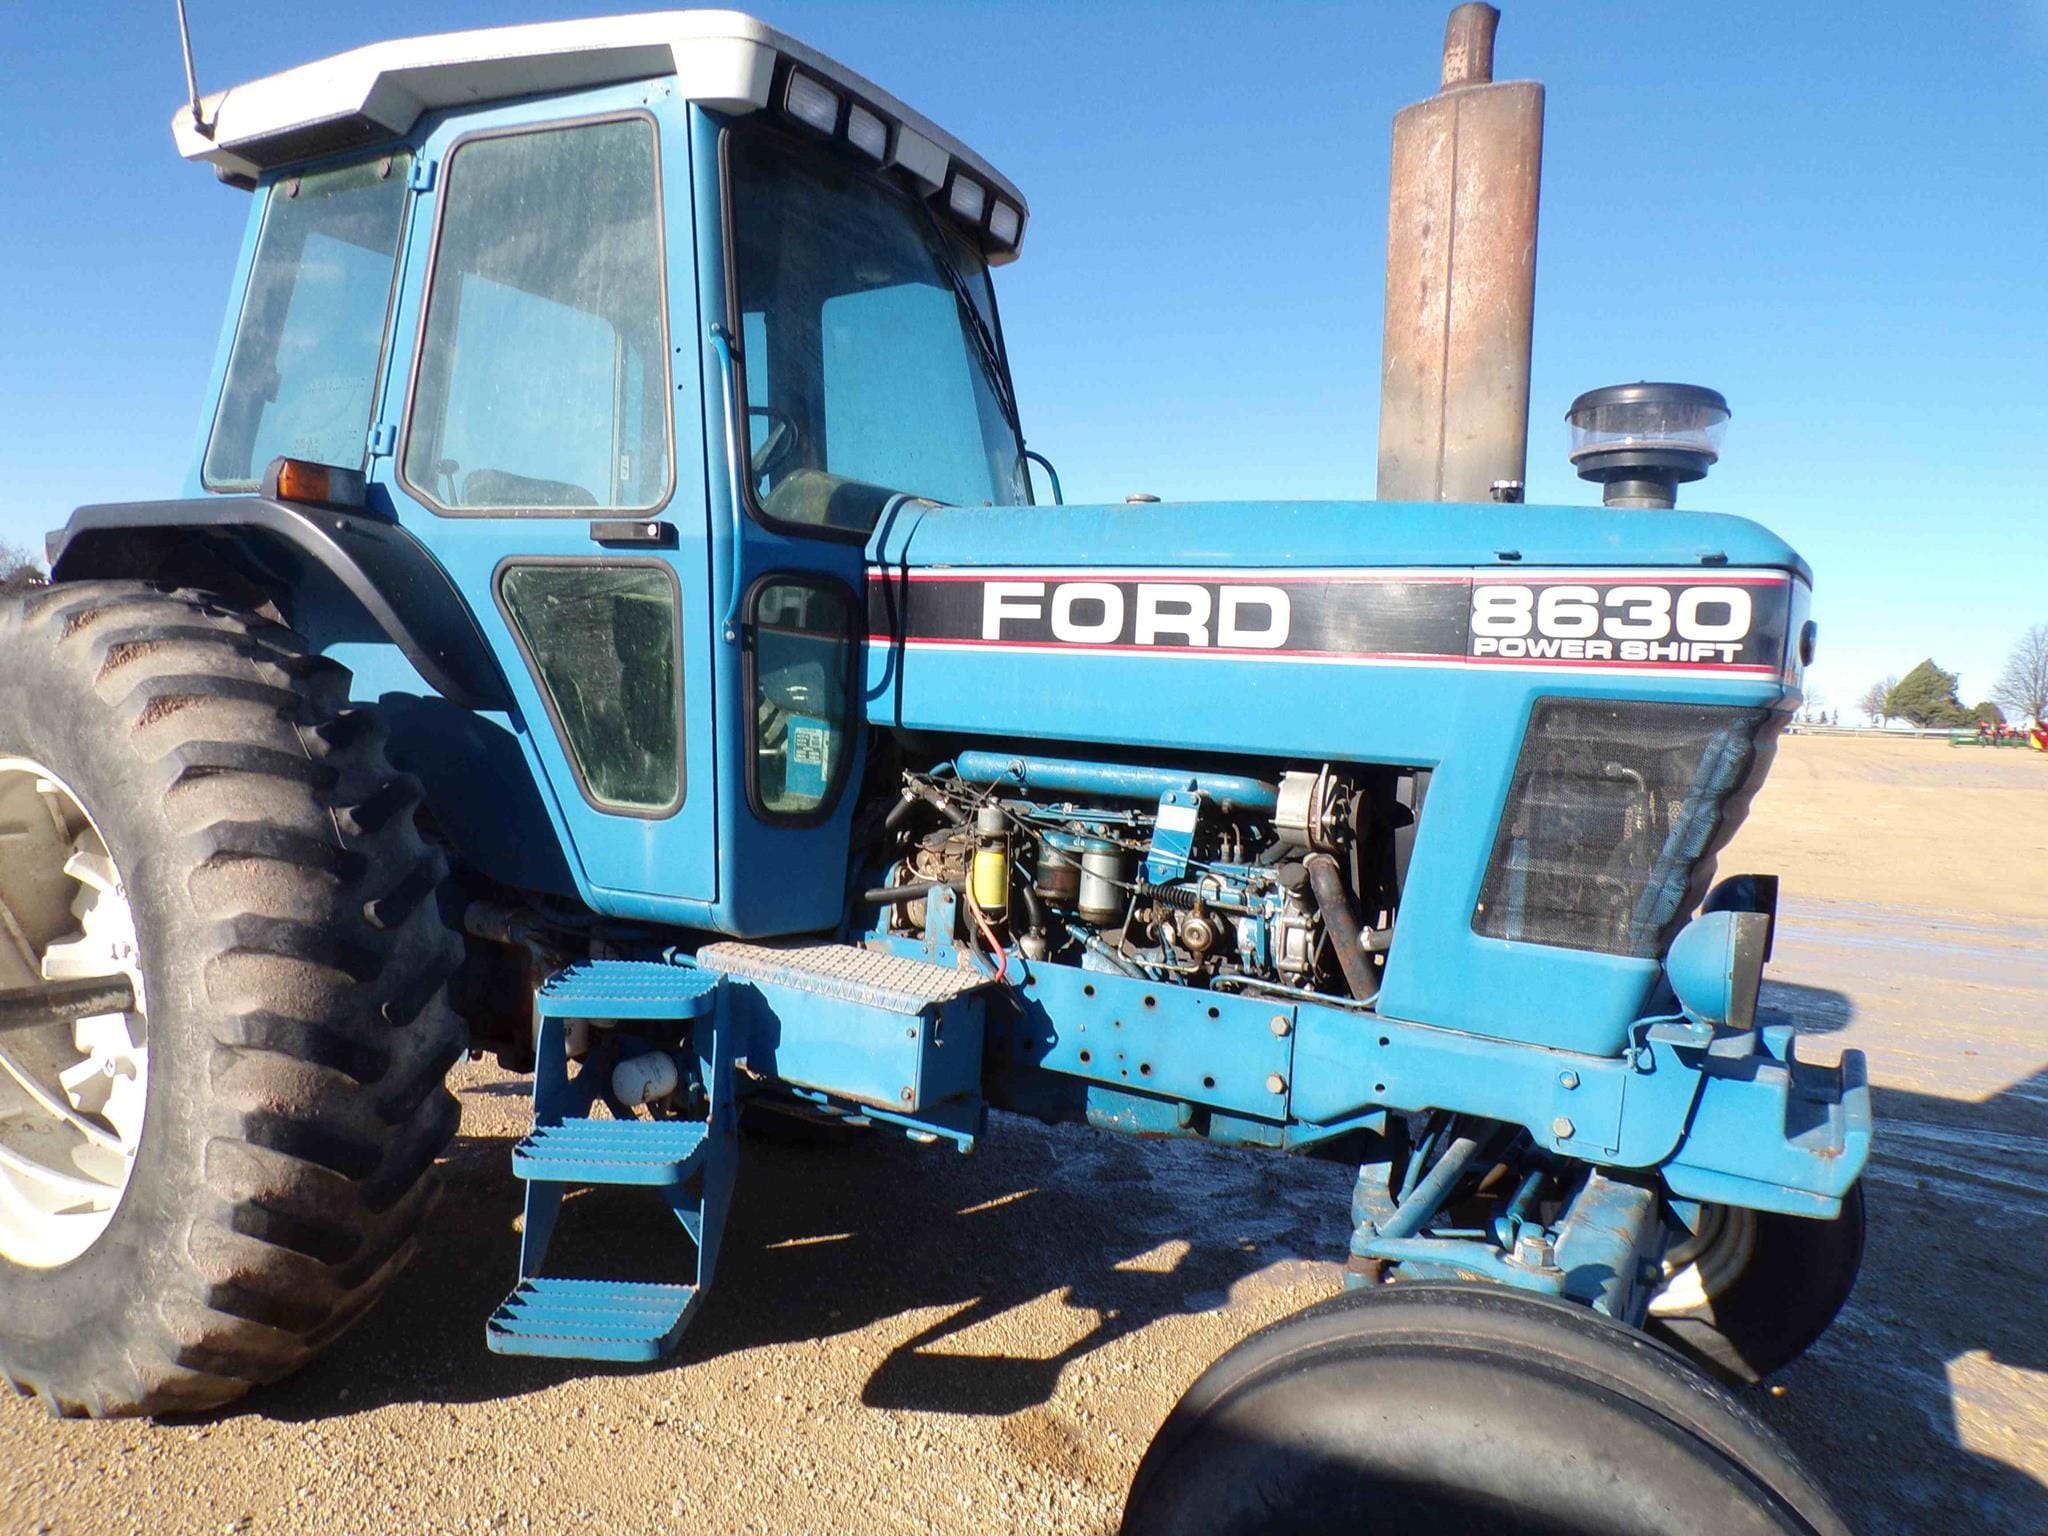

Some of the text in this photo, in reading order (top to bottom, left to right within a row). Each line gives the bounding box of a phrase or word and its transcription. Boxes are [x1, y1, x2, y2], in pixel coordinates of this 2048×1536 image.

[982, 581, 1291, 649] FORD
[1471, 585, 1752, 641] 8630
[1473, 637, 1743, 663] POWER SHIFT
